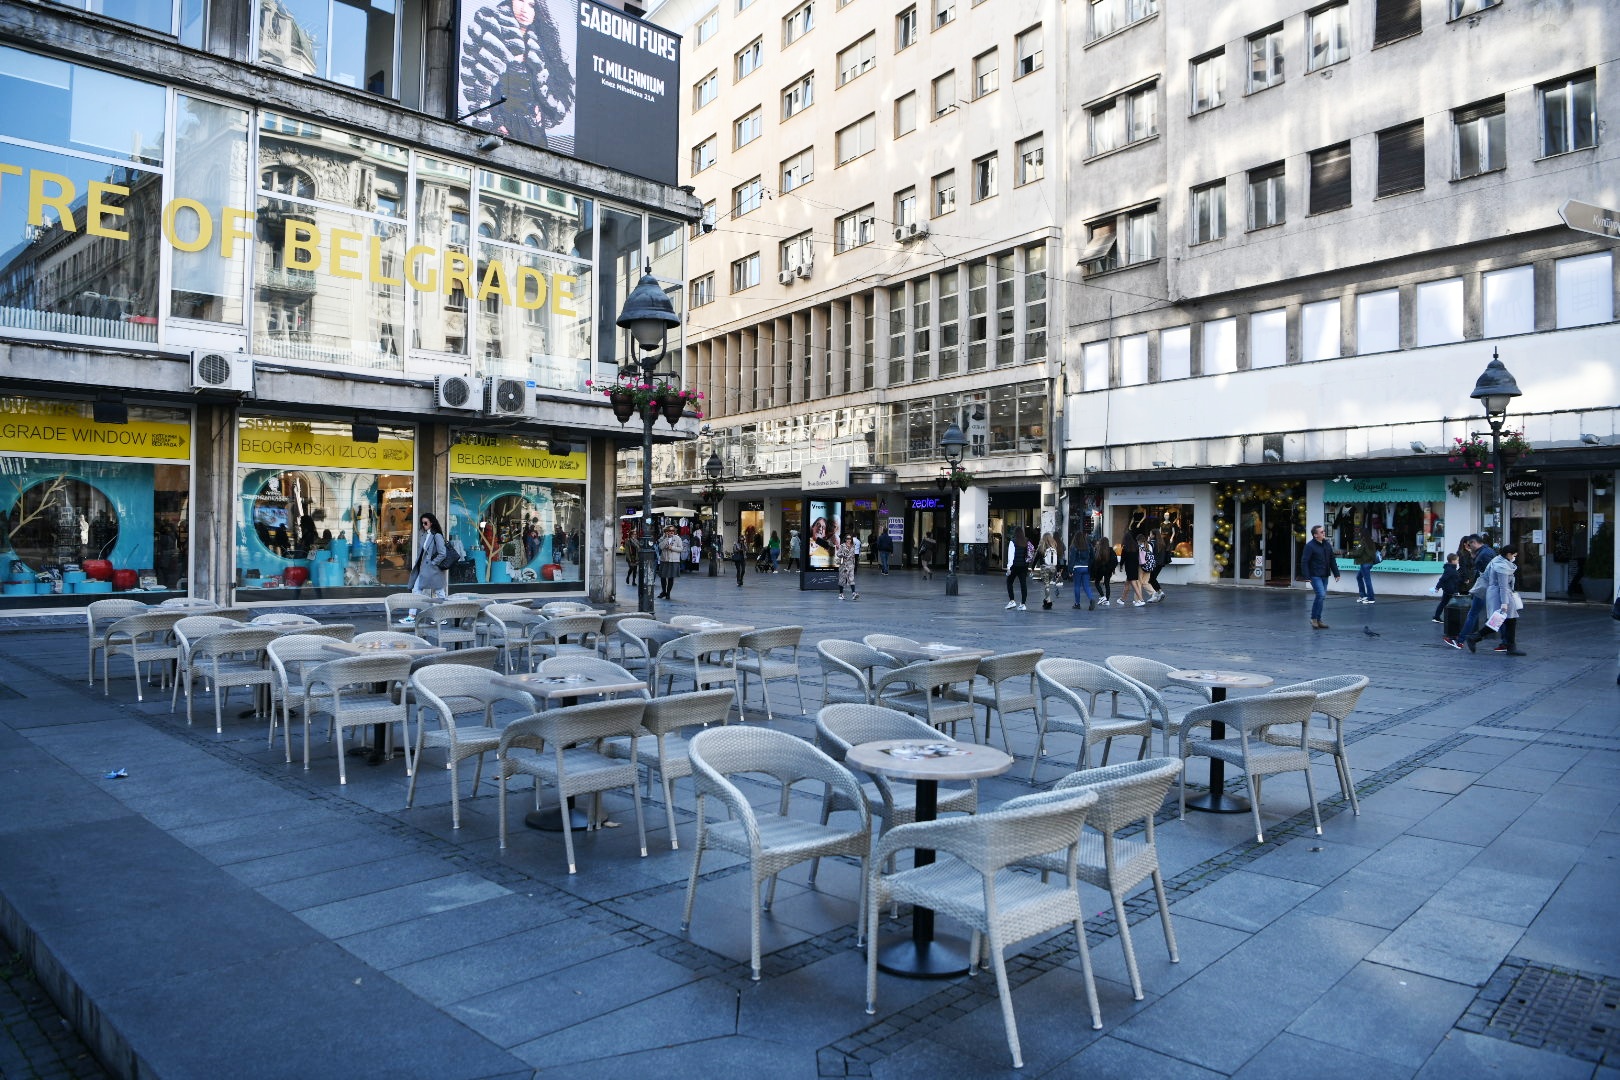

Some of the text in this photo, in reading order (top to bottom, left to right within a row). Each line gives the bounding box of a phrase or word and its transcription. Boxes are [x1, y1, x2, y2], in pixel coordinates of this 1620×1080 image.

[580, 2, 676, 61] SABONI FURS
[593, 54, 665, 96] TC MILLENNIUM
[163, 197, 256, 258] OF
[284, 218, 578, 318] BELGRADE
[0, 423, 148, 446] GRADE WINDOW
[241, 438, 335, 457] BEOGRADSKI
[338, 445, 377, 459] IZLOG
[457, 453, 513, 467] BELGRADE
[515, 457, 557, 469] WINDOW
[1505, 480, 1542, 490] Welcome
